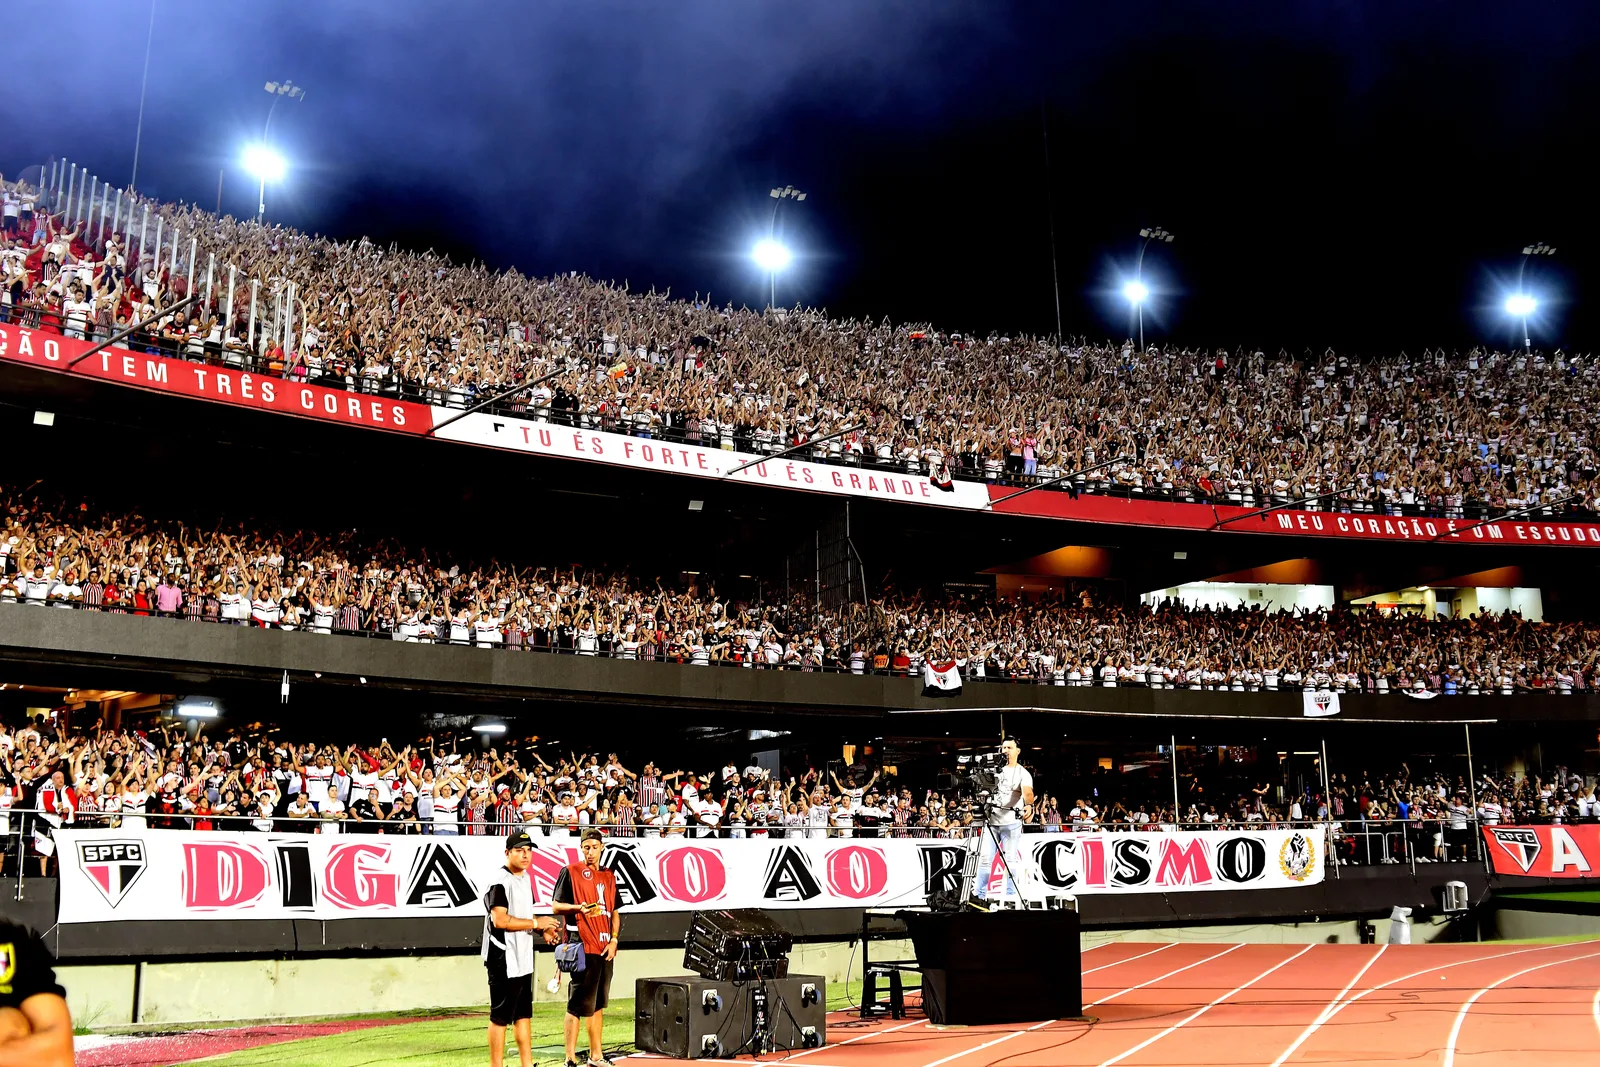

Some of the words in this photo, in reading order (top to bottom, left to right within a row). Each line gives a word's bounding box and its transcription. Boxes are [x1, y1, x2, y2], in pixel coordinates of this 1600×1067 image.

[98, 350, 168, 384] TEM
[194, 369, 276, 403] TRÊS
[301, 389, 406, 426] CORES
[520, 426, 551, 447] TU
[573, 431, 604, 455] ÉS
[624, 441, 720, 474] FORTE,
[739, 458, 768, 478] TU
[786, 462, 814, 484] ÉS
[831, 471, 931, 497] GRANDE
[1277, 513, 1323, 530] MEU
[1337, 516, 1438, 538] CORAÇÃO
[1448, 520, 1459, 537] É
[1472, 524, 1503, 539] UM
[1515, 525, 1600, 542] ESCUDO
[84, 845, 140, 861] SPFC
[1497, 831, 1535, 843] SPFC
[1551, 828, 1591, 872] A
[181, 839, 479, 912] DIGA
[527, 842, 728, 908] NÃO
[762, 845, 888, 901] AO
